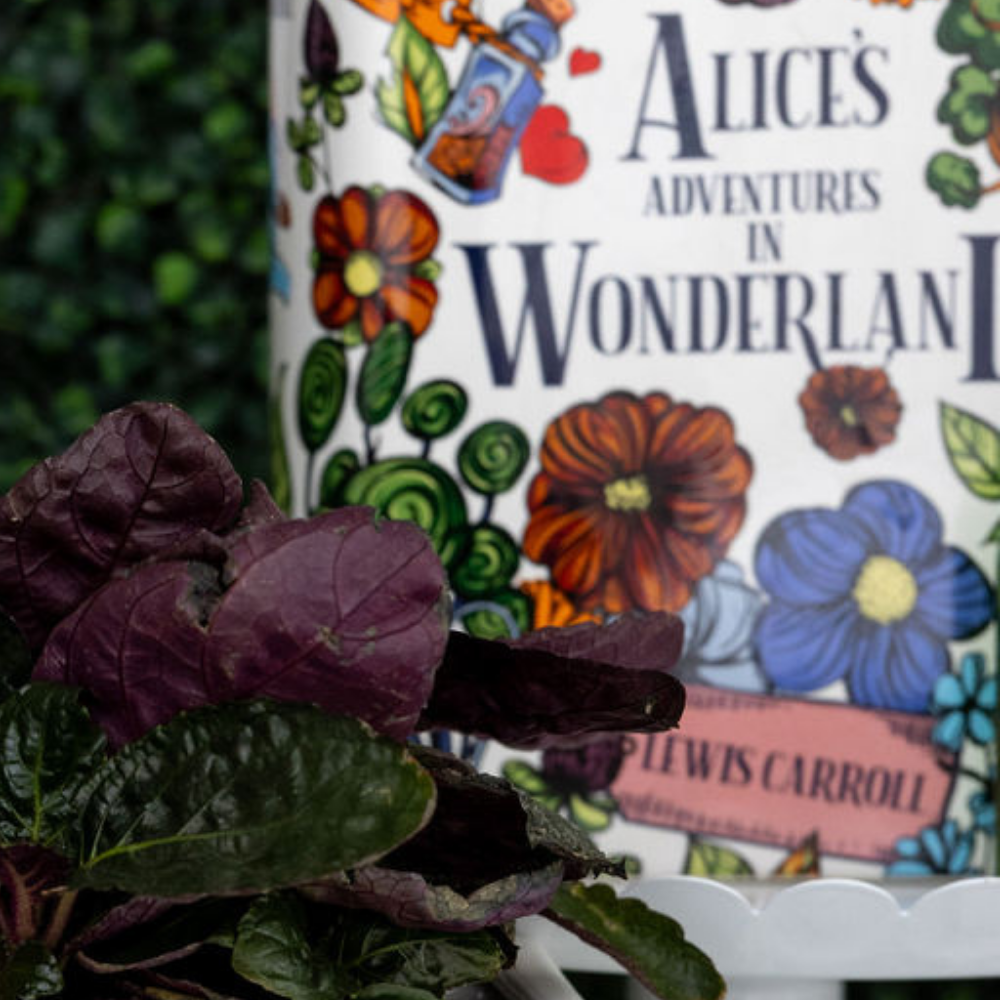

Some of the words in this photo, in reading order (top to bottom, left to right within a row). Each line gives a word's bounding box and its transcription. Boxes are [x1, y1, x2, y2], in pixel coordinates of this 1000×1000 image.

[618, 12, 891, 162] ALICE'S
[643, 169, 882, 217] ADVENTURES
[747, 221, 784, 264] IN
[640, 733, 753, 787] LEWIS
[761, 750, 927, 815] CARROLL
